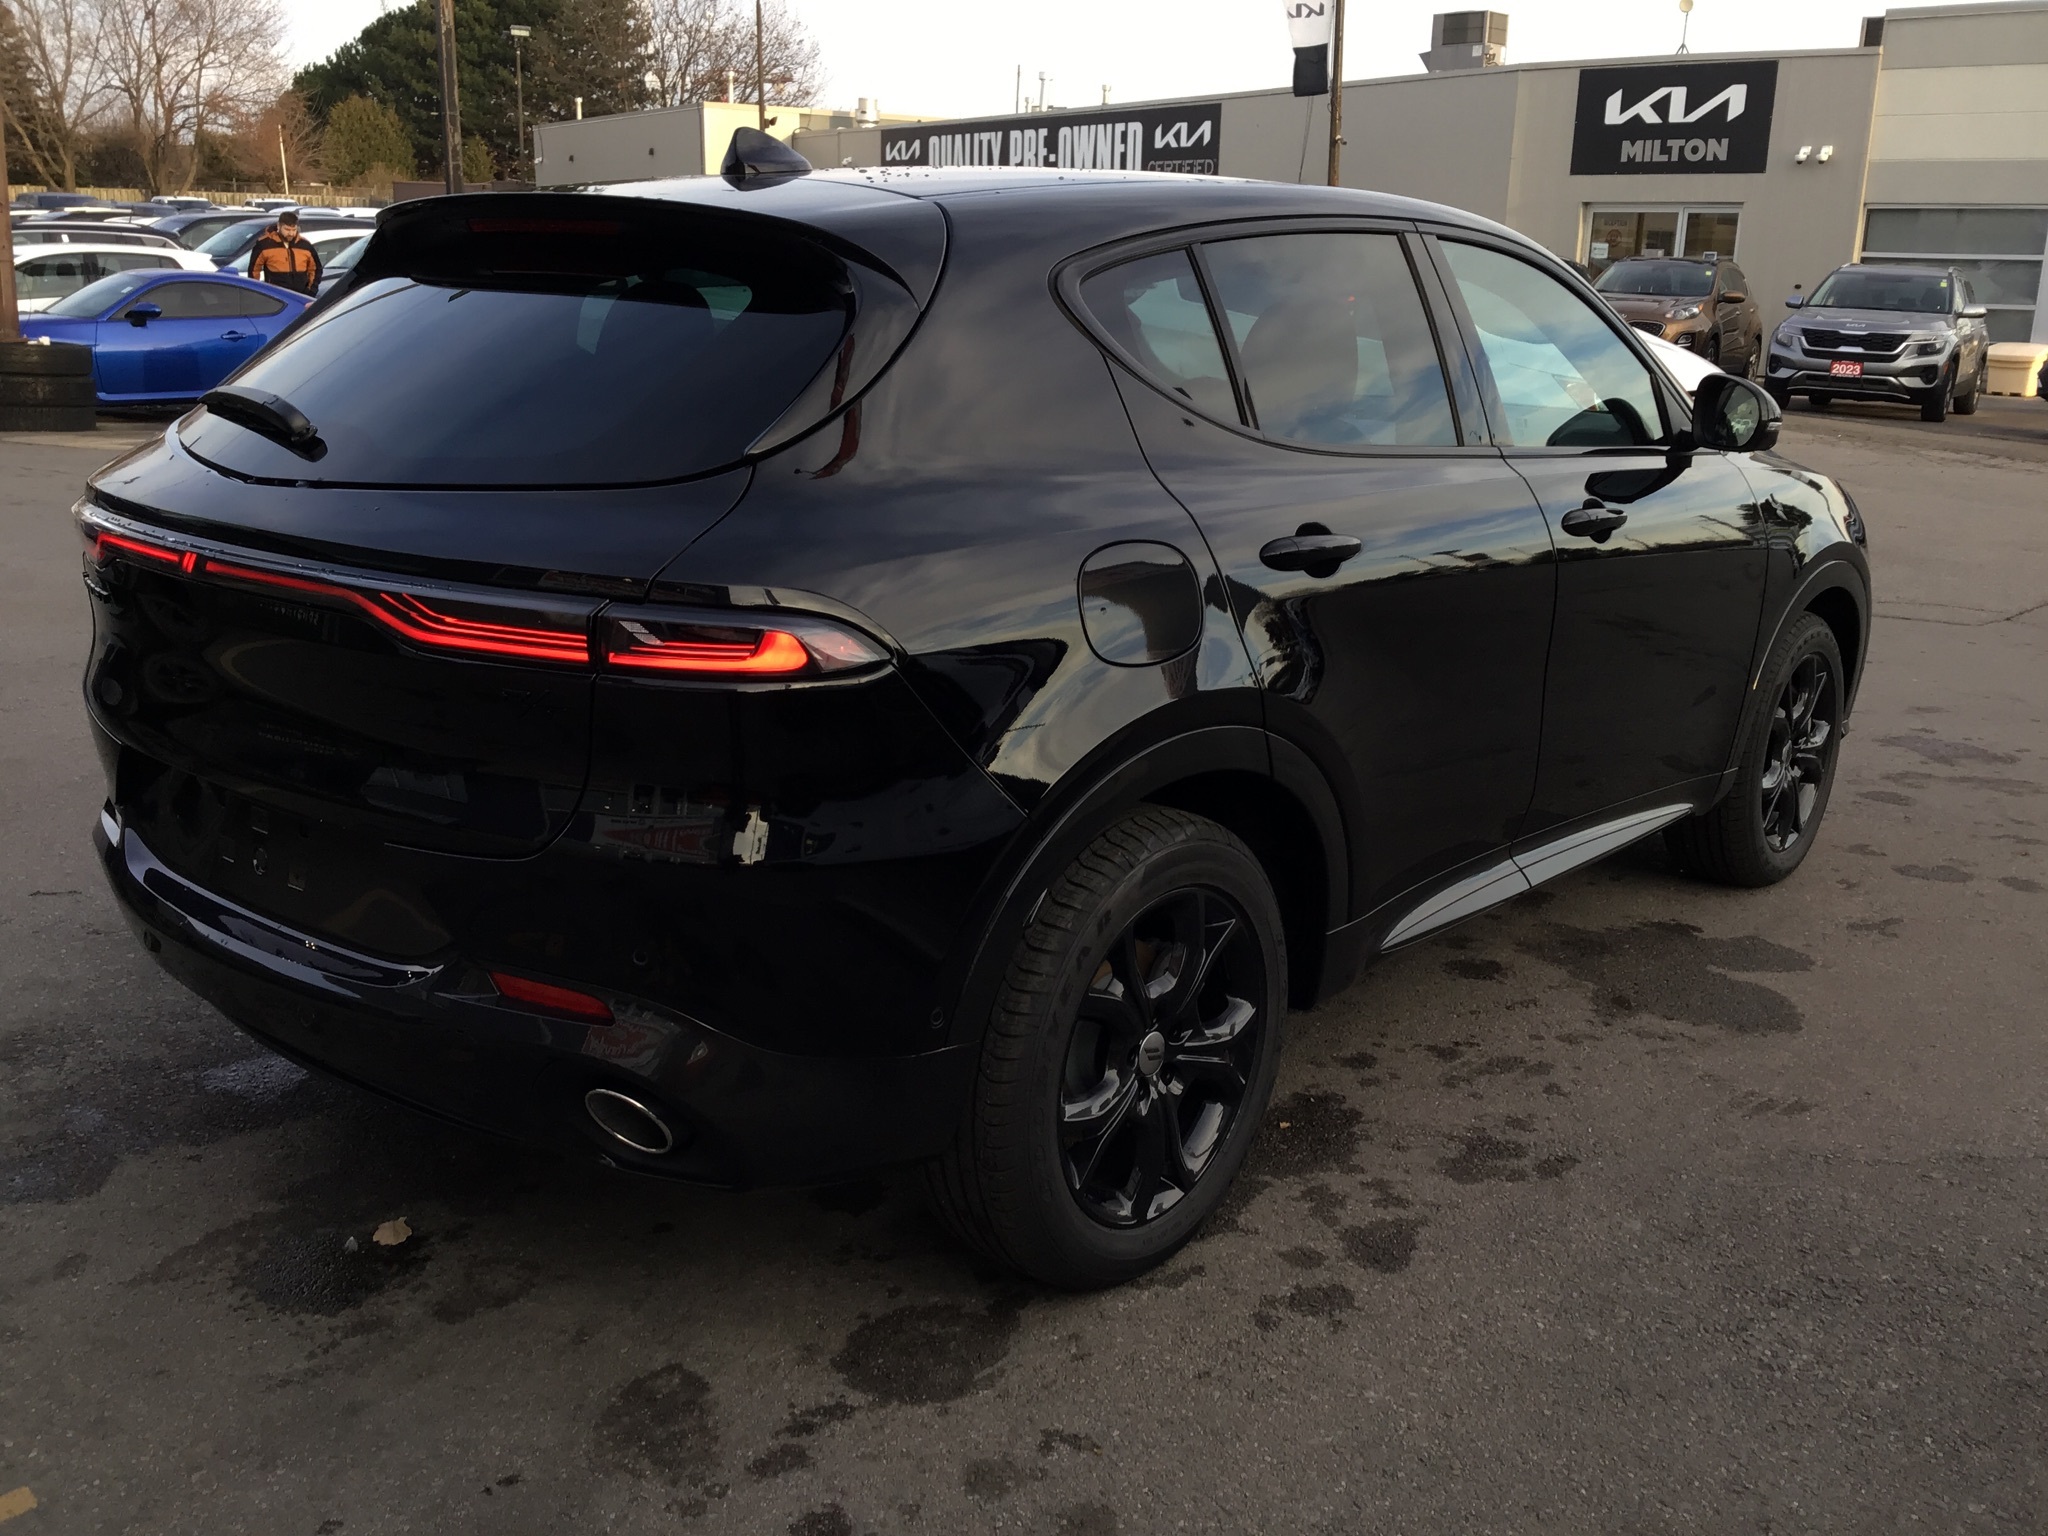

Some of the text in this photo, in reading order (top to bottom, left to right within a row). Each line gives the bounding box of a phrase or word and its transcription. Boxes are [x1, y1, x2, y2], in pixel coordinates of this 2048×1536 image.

[1604, 83, 1748, 125] KIA
[928, 121, 1143, 171] QUALITY PRE-OWNED
[1154, 120, 1211, 149] KIA
[885, 139, 921, 161] KIA
[1620, 137, 1730, 163] MILTON
[1831, 363, 1861, 375] 2023
